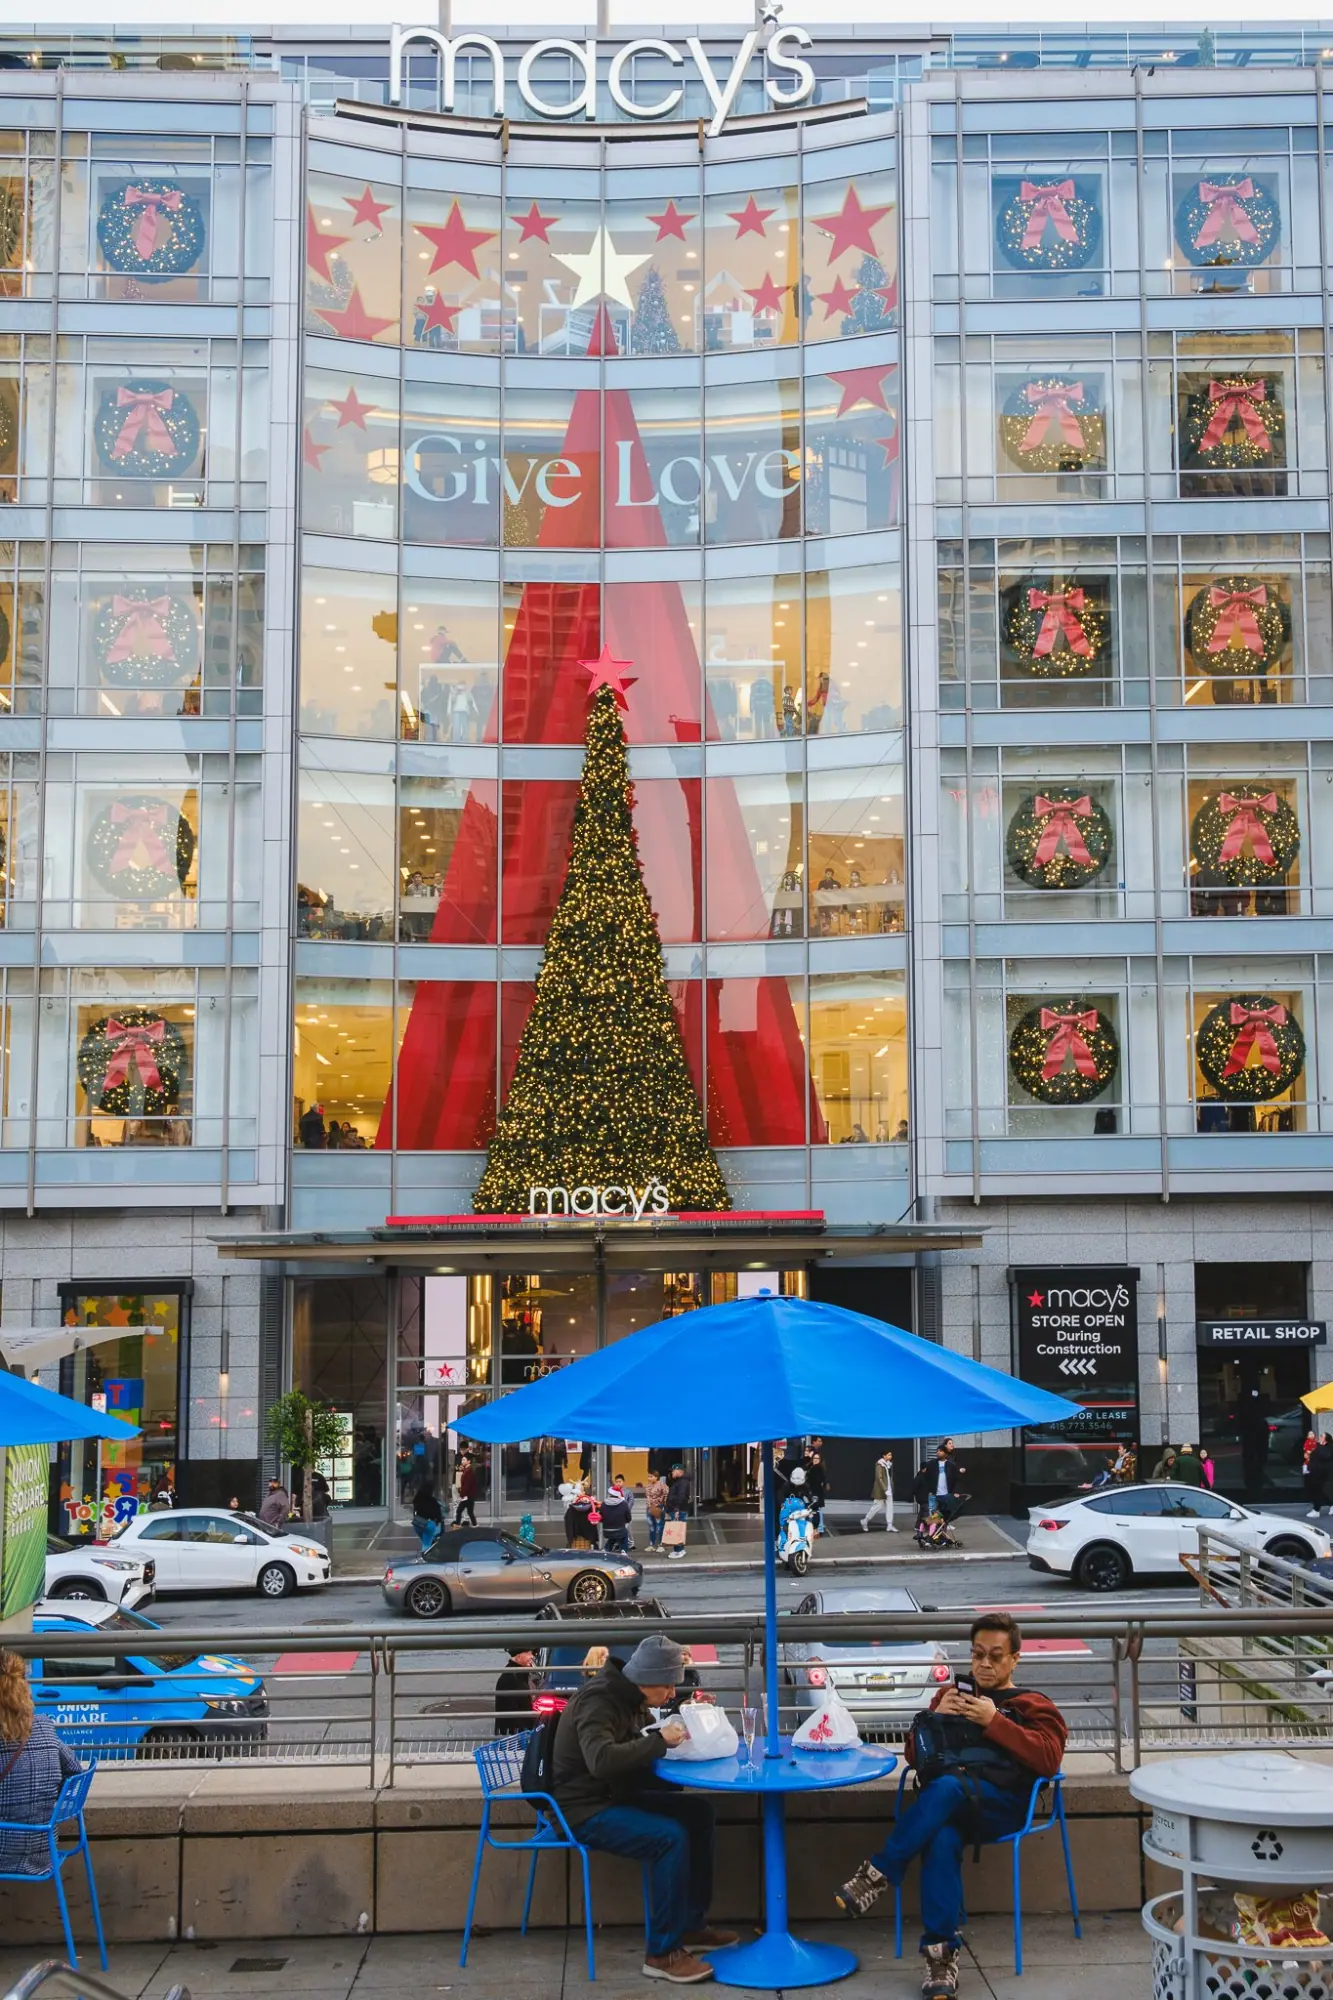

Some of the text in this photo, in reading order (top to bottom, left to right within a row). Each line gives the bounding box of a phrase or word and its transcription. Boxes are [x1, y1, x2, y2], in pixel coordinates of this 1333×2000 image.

[404, 434, 801, 508] Give Love
[1031, 1314, 1125, 1327] STORE OPEN
[1056, 1330, 1101, 1343] During
[1212, 1326, 1320, 1340] RETAIL SHOP
[1036, 1343, 1121, 1355] Construction
[1096, 1411, 1128, 1420] LEASE
[12, 1455, 41, 1488] UNION
[11, 1483, 45, 1516] SQUARE
[62, 1728, 93, 1736] ALLIANCE
